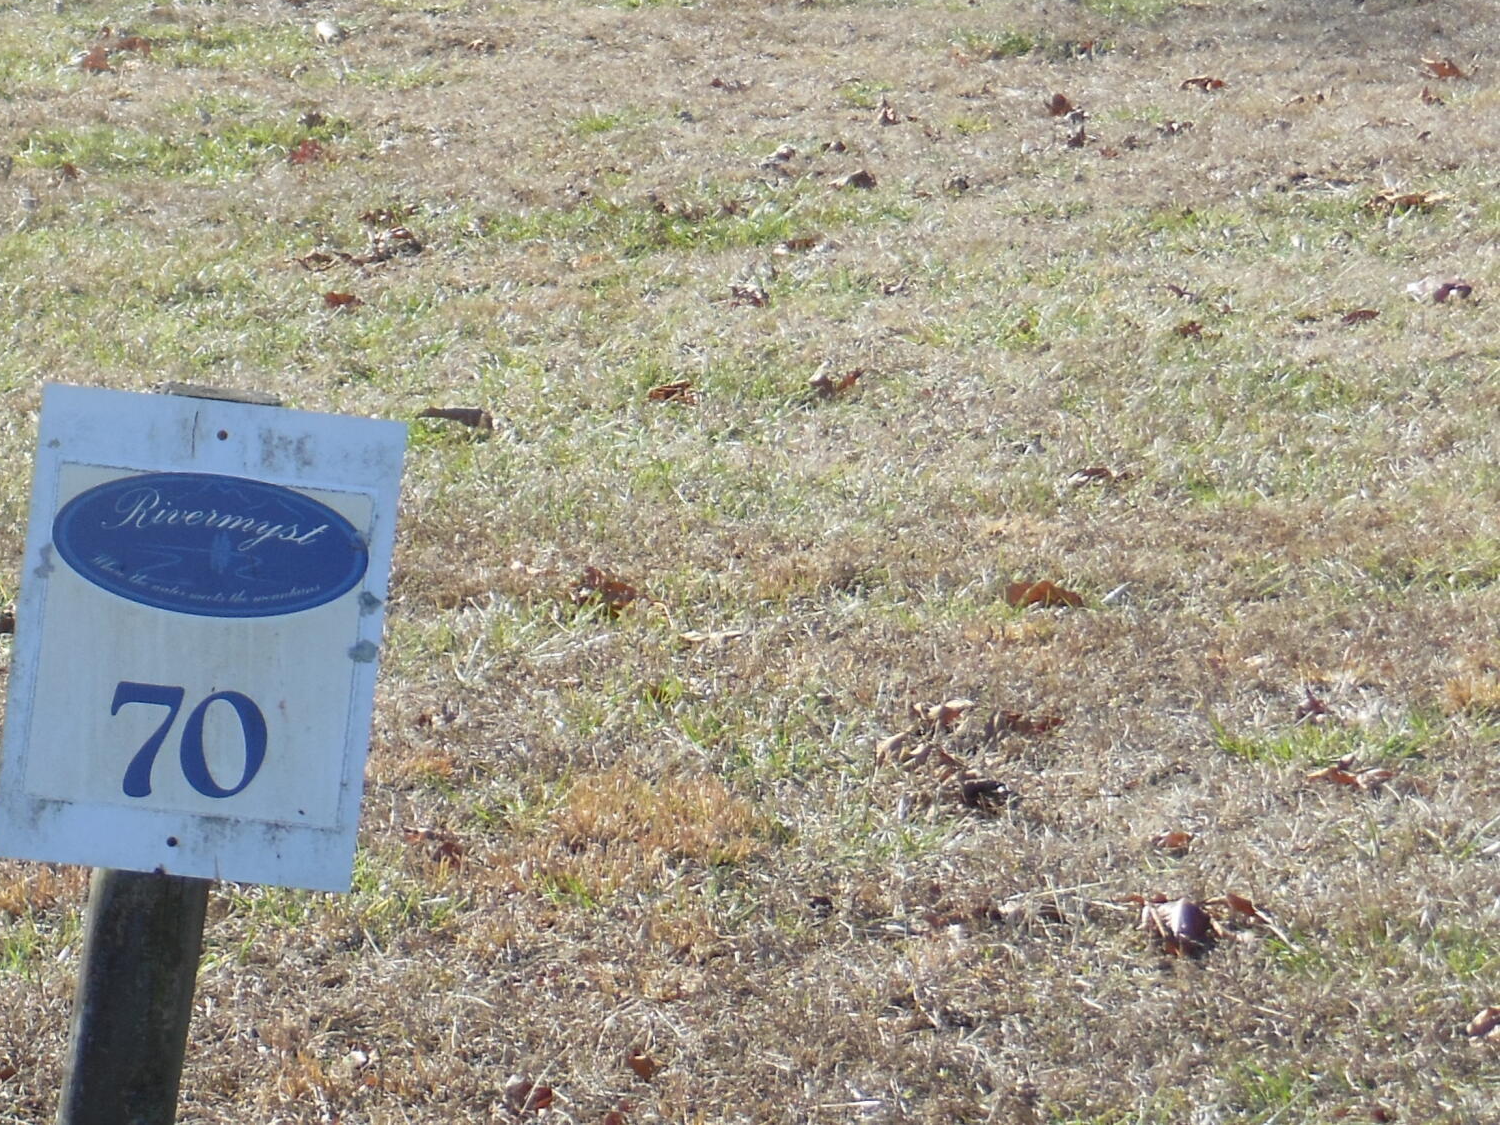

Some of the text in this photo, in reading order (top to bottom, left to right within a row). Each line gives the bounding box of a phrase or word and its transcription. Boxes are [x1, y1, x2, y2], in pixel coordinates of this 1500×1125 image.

[102, 488, 329, 552] Rivermyst
[228, 588, 248, 604] the
[110, 680, 268, 801] 70
